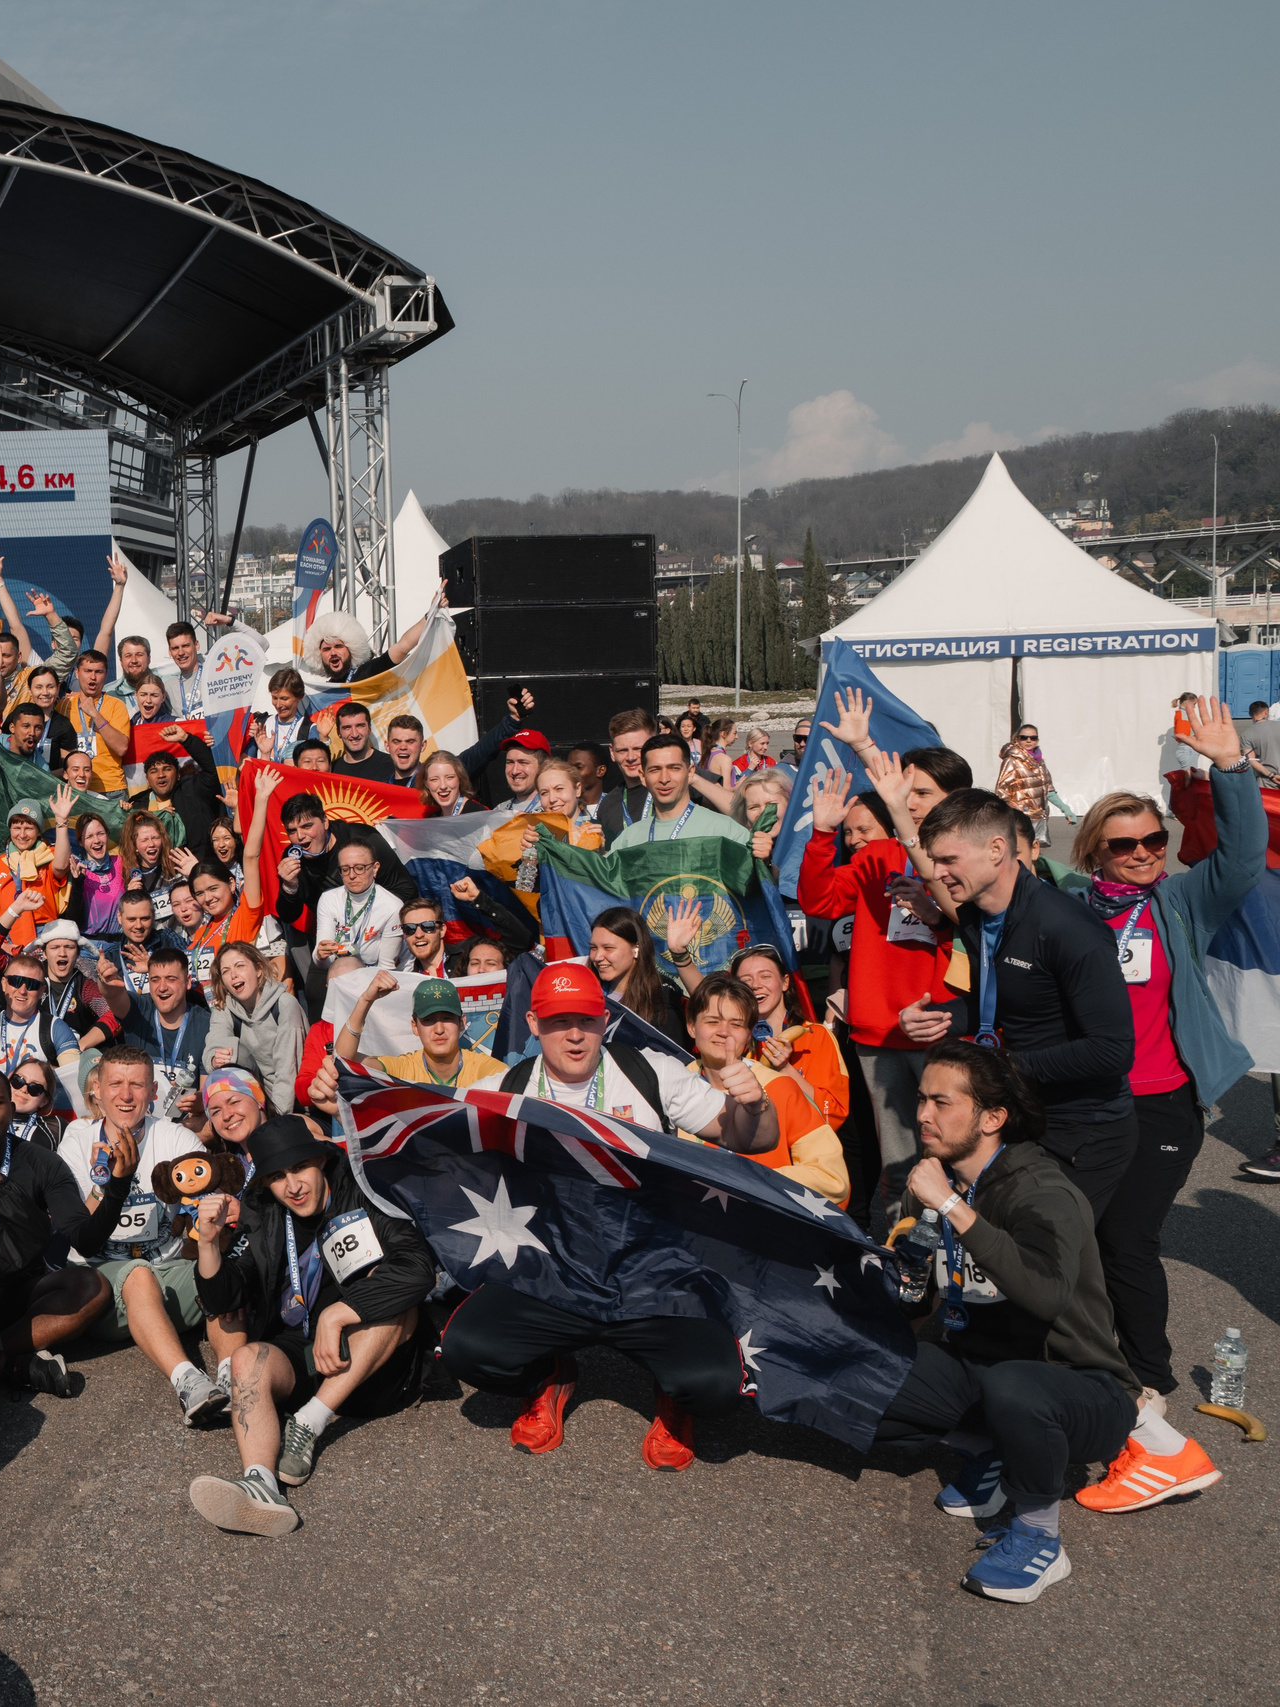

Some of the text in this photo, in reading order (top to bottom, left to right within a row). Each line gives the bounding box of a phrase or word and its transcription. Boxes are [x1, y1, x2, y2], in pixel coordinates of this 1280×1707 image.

[853, 640, 1000, 660] ЕГИСТРАЦИЯ
[1023, 632, 1200, 653] REGISTRATION
[206, 673, 253, 688] НАВСТРЕЧУ
[208, 680, 254, 696] ДРУГ ДРУГУ
[678, 808, 692, 826] ДРУГУ
[1117, 920, 1135, 962] АВСТРЕЧУ
[1130, 902, 1144, 921] ДРУГ
[586, 1085, 598, 1108] ДРУГ
[330, 1233, 361, 1262] 138
[288, 1241, 301, 1291] НАВСТРЕЧУ
